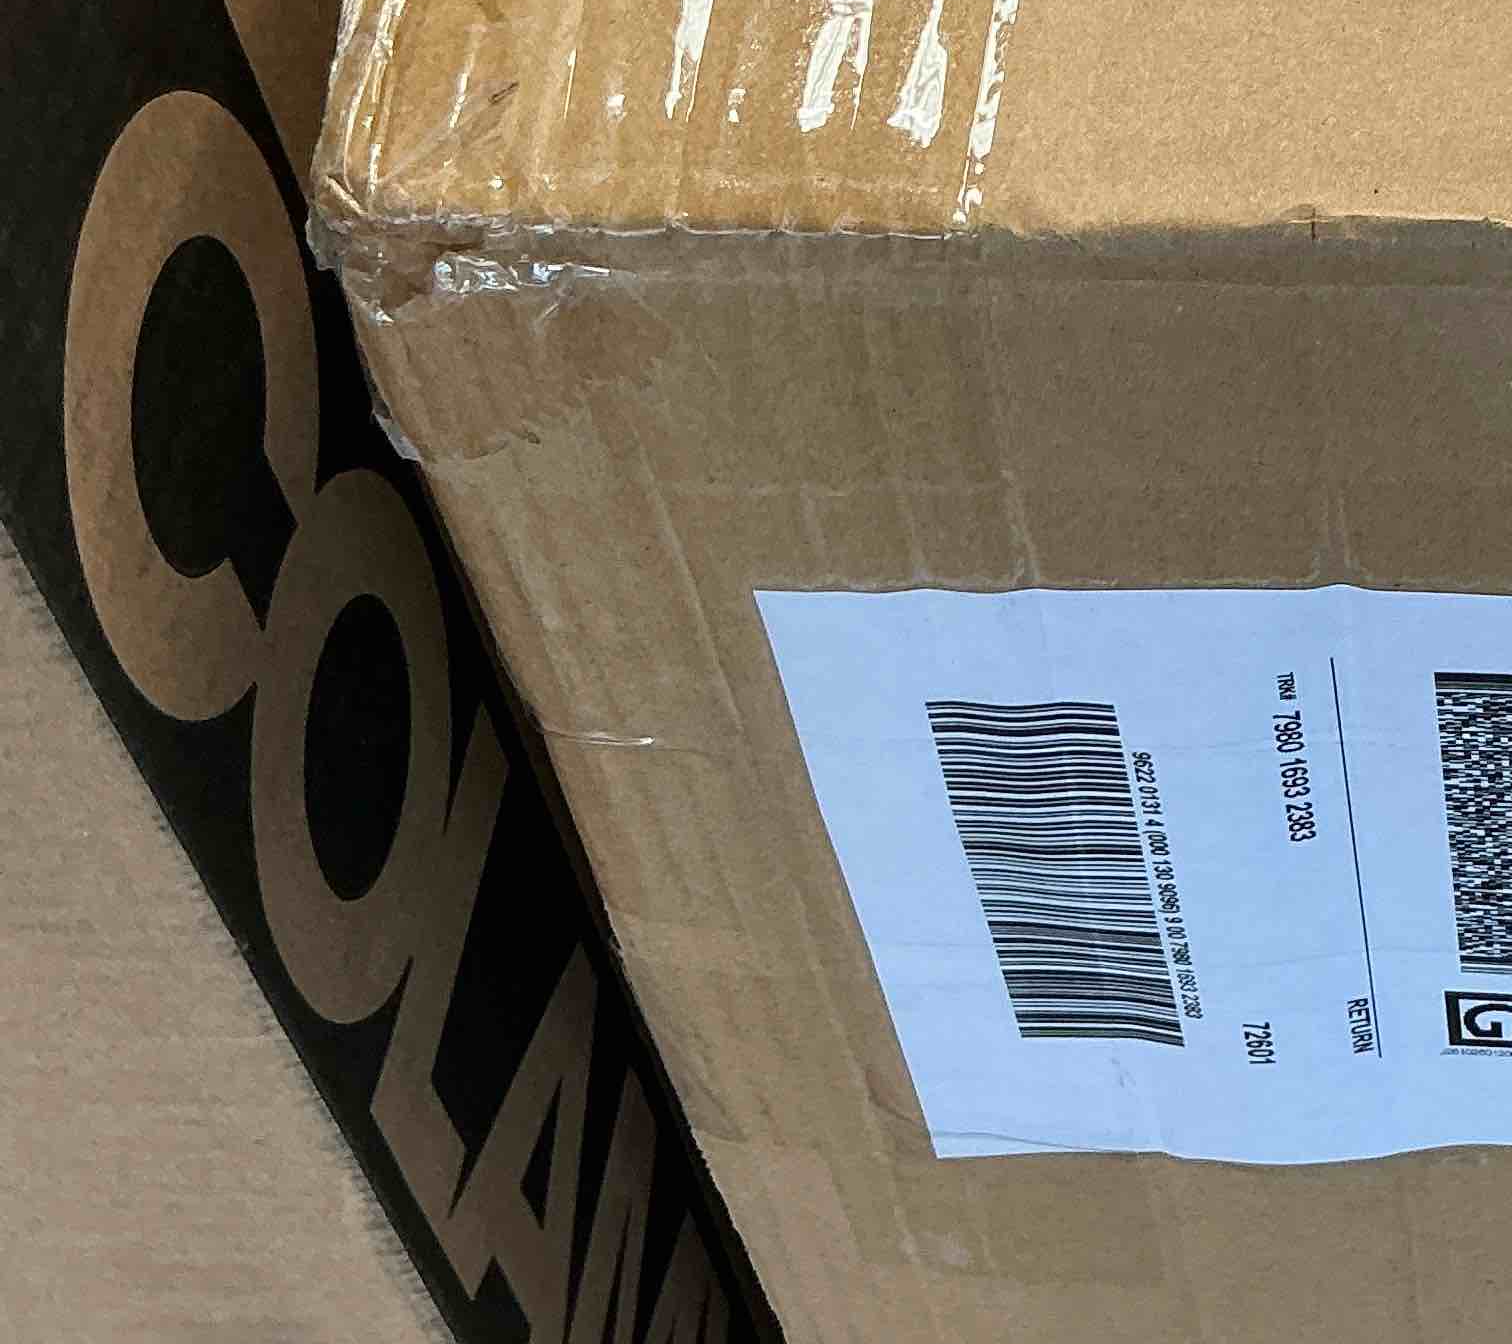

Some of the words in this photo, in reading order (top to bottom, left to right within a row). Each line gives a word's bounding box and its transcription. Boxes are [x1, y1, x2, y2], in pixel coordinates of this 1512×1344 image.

[1277, 671, 1297, 700] TRK#
[1272, 710, 1305, 753] 7980
[1132, 752, 1156, 783] 9622
[1279, 758, 1310, 798] 1693
[1138, 786, 1163, 815] 0131
[1285, 802, 1316, 842] 2383
[1142, 830, 1170, 856] (000
[1152, 860, 1175, 880] 130
[1158, 883, 1180, 913] 9096)
[1166, 926, 1187, 939] 00
[1170, 942, 1192, 965] 7980
[1181, 994, 1204, 1019] 2383
[1347, 998, 1375, 1054] RETURN
[1242, 1022, 1276, 1064] 72601
